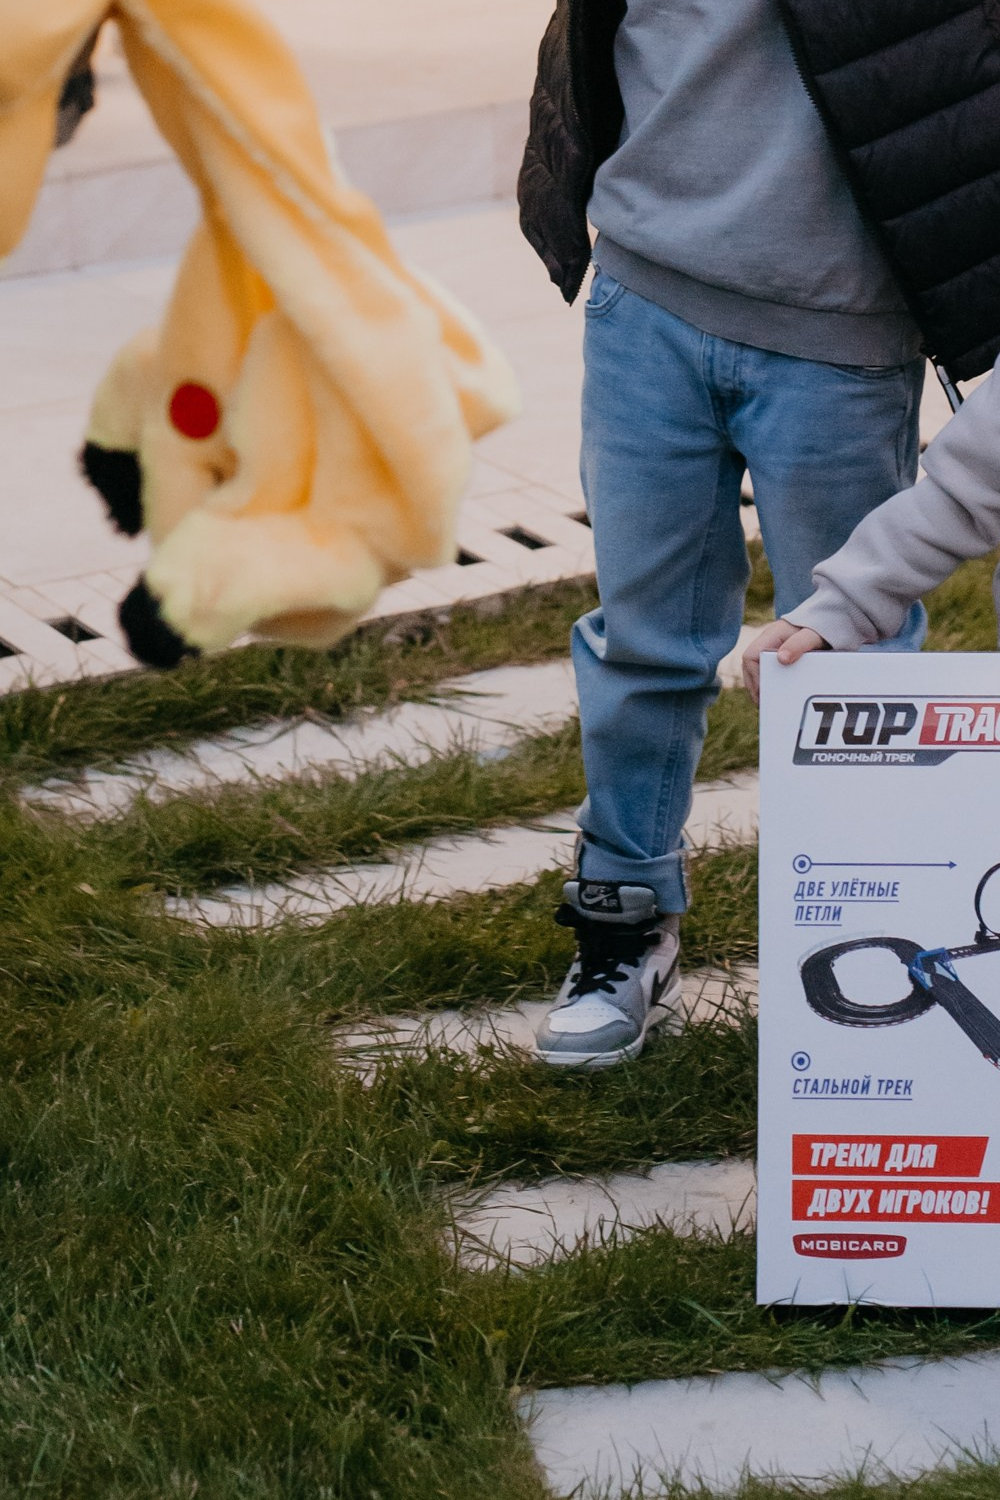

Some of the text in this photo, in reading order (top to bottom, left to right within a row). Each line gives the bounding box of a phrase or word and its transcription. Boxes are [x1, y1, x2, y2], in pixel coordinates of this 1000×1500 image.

[812, 702, 919, 746] TOP
[811, 751, 916, 764] ГОНОЧНЫЙ ТРЕК
[794, 877, 900, 900] ДВЕ УЛЁТНЫЕ
[794, 905, 842, 921] ПЕТЛИ
[792, 1074, 914, 1096] СТАЛЬНОЙ ТРЕК
[810, 1142, 938, 1173] ТРЕКИ ДЛЯ
[806, 1188, 991, 1217] ДВУХ ИГРОКОВ!
[801, 1240, 900, 1252] MOBICARO
